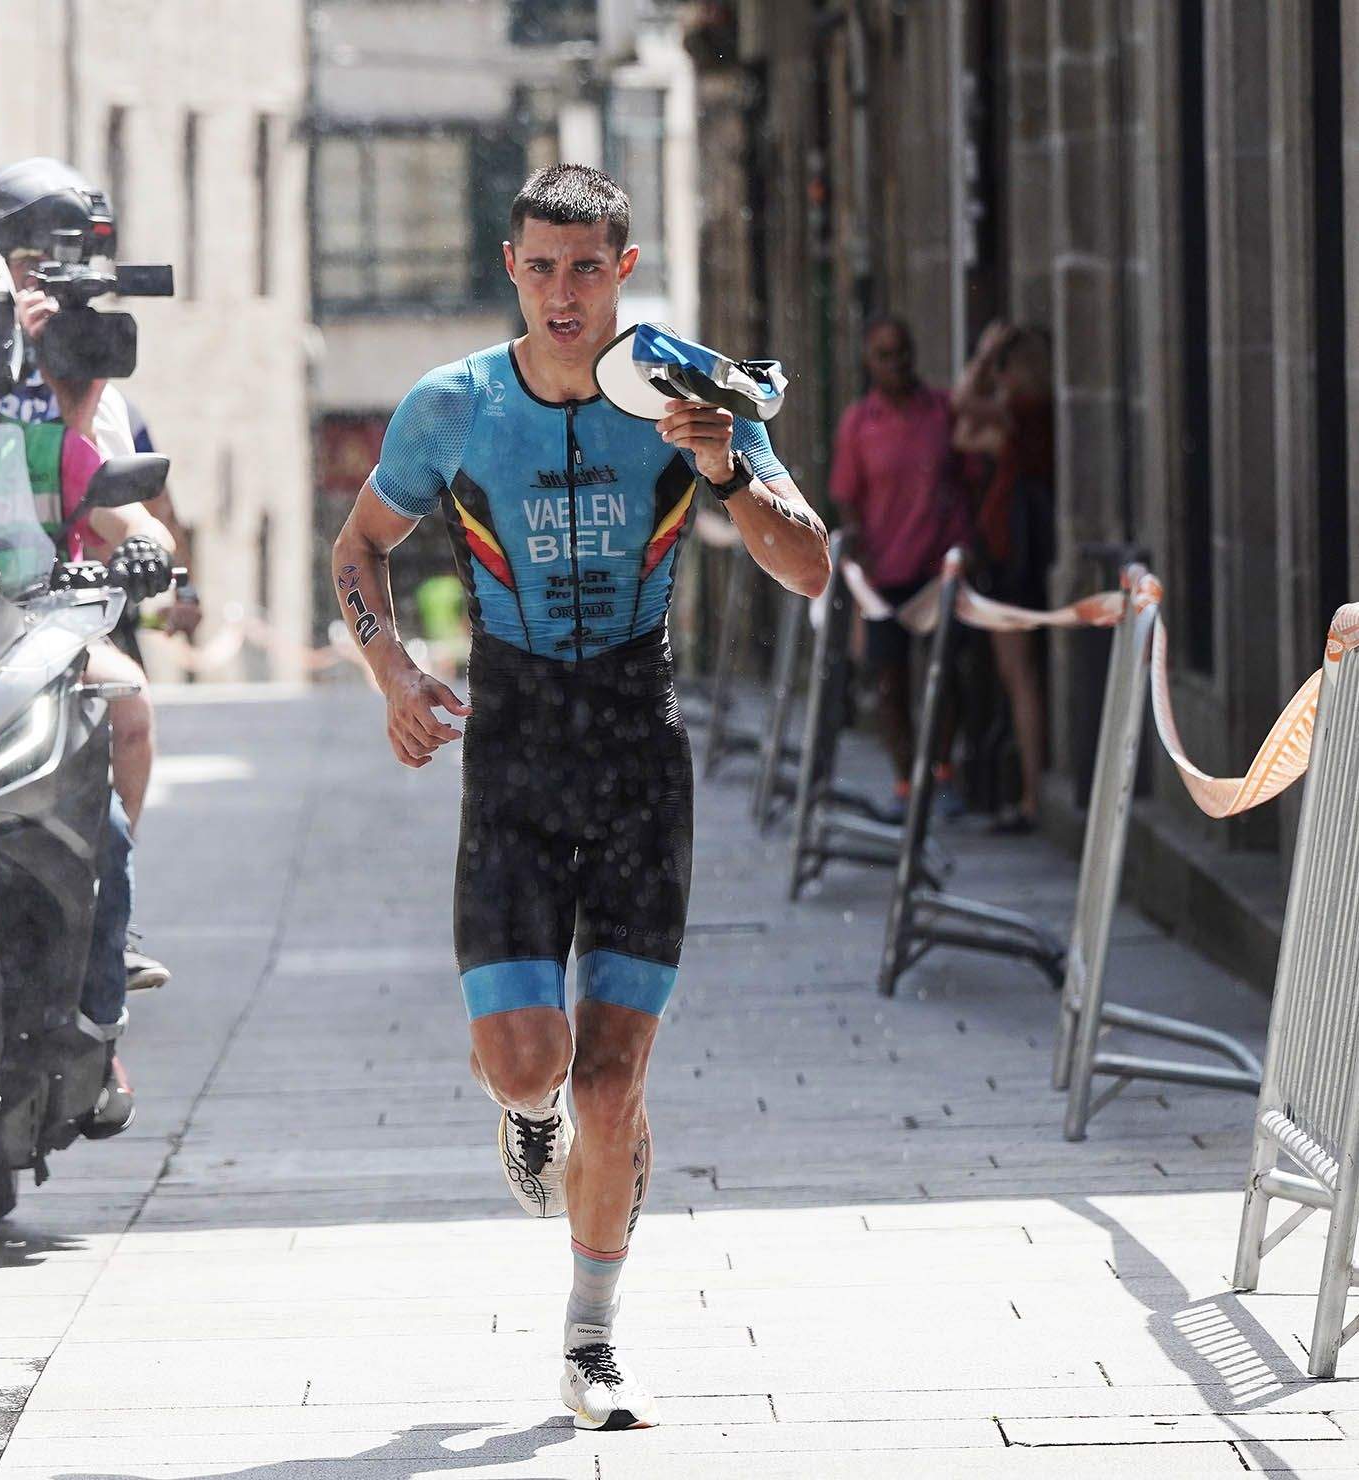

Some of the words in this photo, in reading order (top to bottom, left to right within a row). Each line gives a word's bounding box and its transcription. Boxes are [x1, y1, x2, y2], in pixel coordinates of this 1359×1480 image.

[527, 530, 626, 563] BEL
[546, 590, 571, 599] Pro
[581, 586, 616, 595] Team
[346, 588, 382, 648] 12
